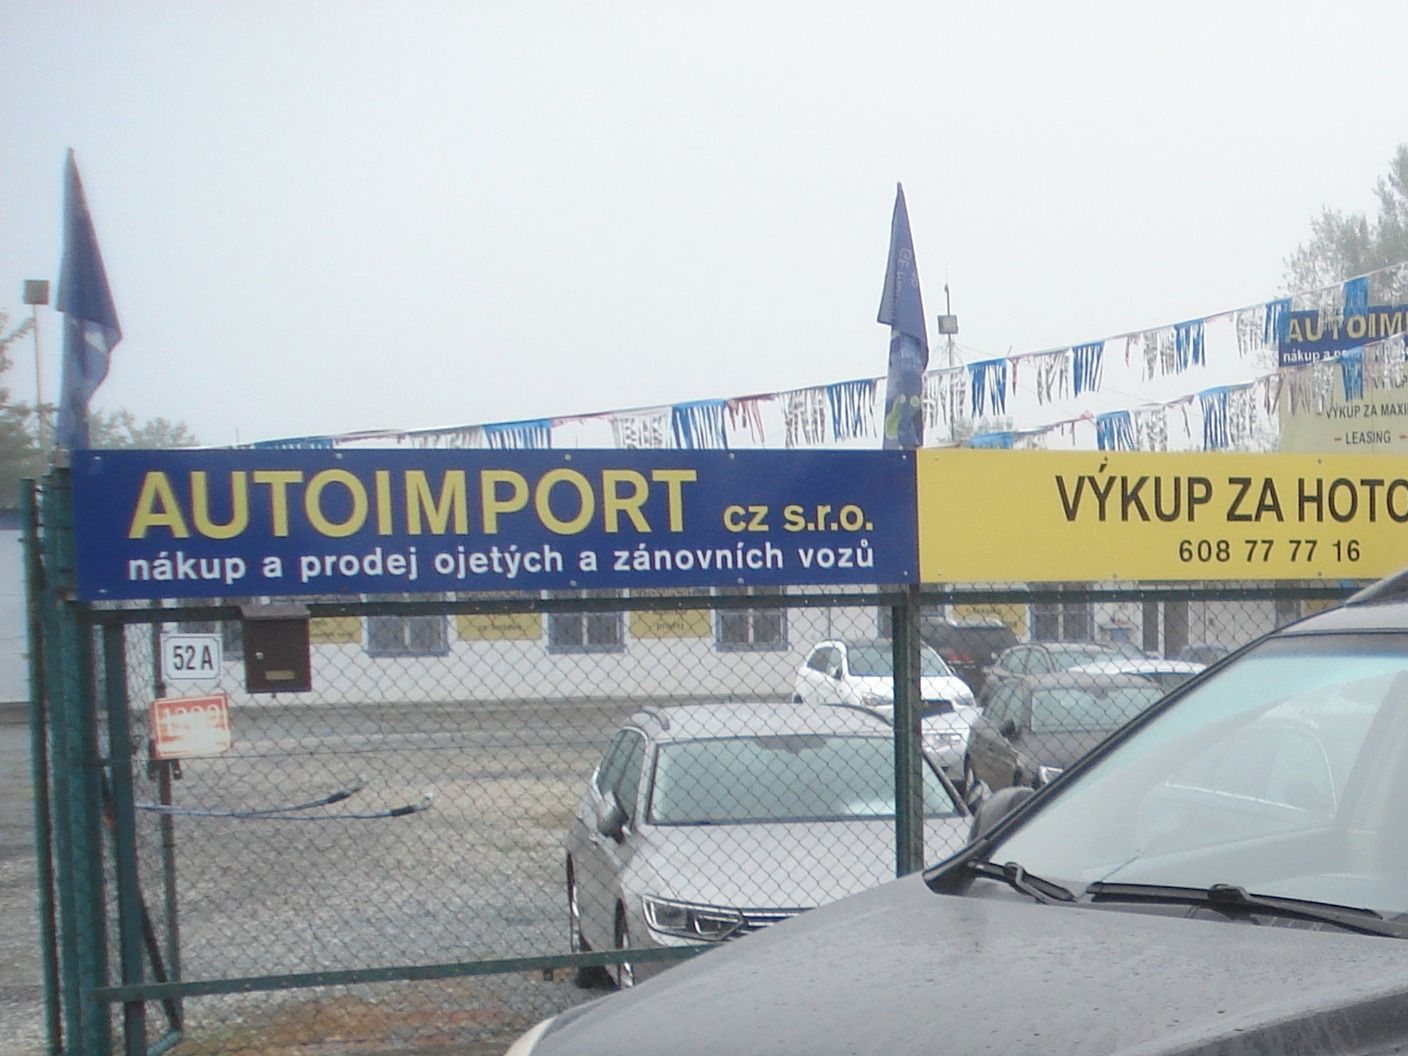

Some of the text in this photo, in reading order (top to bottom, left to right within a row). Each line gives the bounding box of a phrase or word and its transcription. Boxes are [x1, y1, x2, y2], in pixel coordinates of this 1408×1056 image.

[1364, 404, 1378, 418] ZA
[1345, 430, 1391, 445] LEASING
[128, 469, 875, 539] AUTOIMPORT cz s.r.o.
[1055, 463, 1214, 523] VÝKUP
[1226, 477, 1284, 523] ZA
[128, 540, 875, 584] nákup a prodej ojetých a zánovních vozů
[1178, 539, 1361, 563] 608 77 77 16
[173, 645, 213, 671] 52 A
